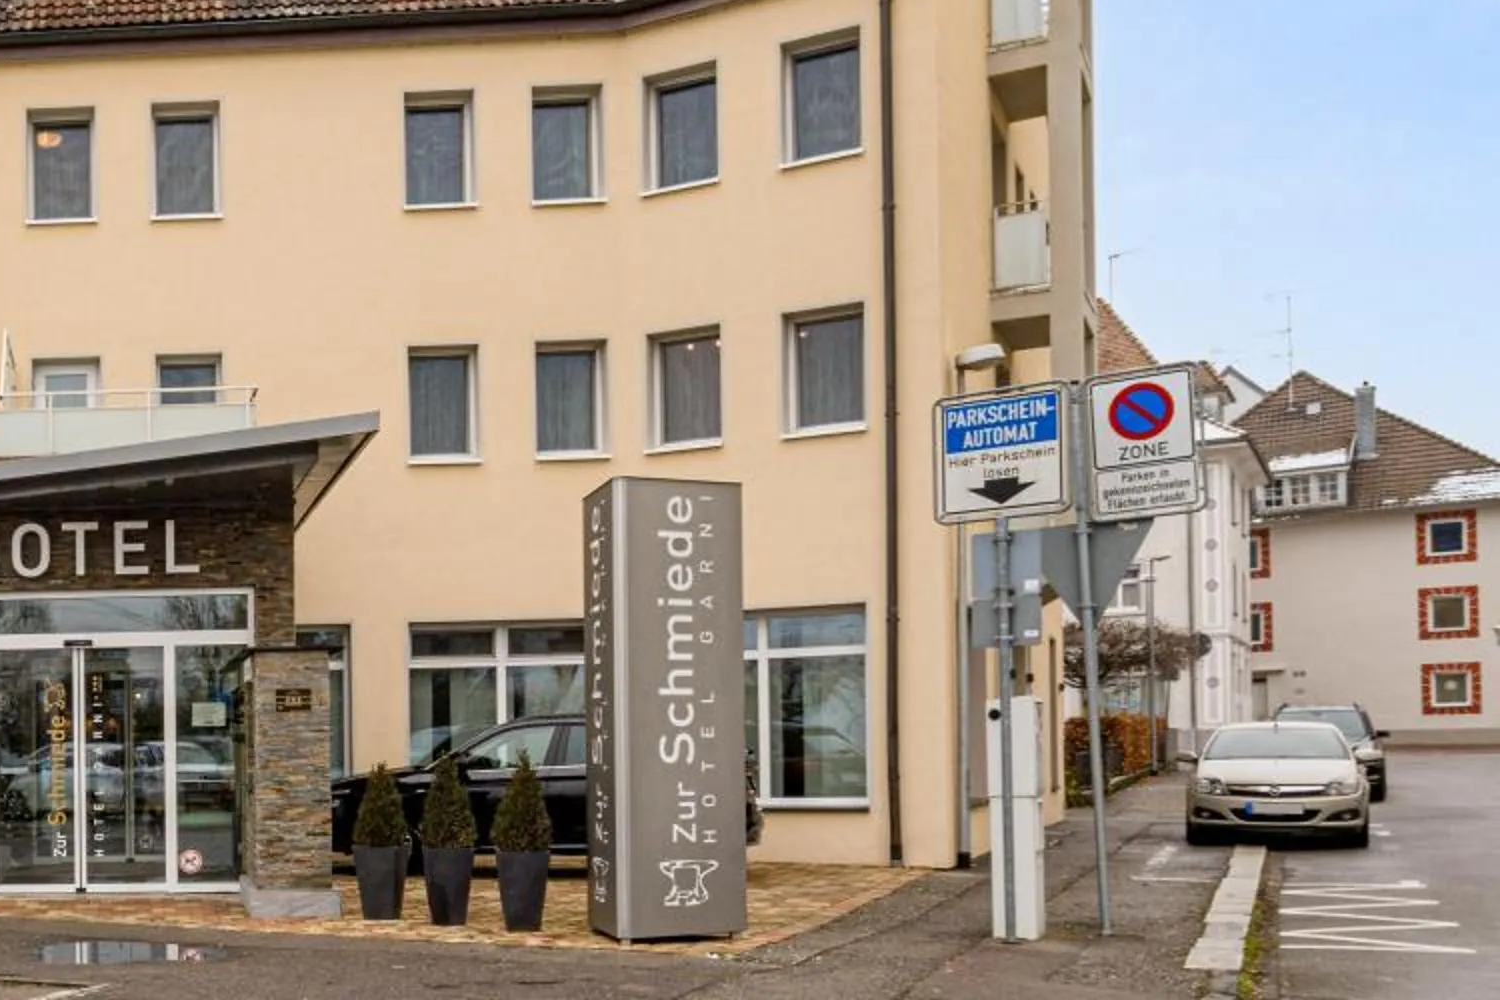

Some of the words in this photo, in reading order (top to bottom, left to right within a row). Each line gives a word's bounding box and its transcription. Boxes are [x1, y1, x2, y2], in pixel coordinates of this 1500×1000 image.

[946, 397, 1055, 429] PARKSCHEIN-
[963, 421, 1039, 449] AUTOMAT
[980, 446, 1056, 464] Parkschein
[1118, 441, 1170, 460] ZONE
[699, 495, 716, 643] GARNI
[657, 495, 696, 765] Schmiede
[46, 714, 67, 825] Schmiede
[700, 690, 718, 843] HOTEL
[93, 791, 105, 857] HOTEL
[672, 781, 697, 843] Zur
[53, 831, 67, 857] Zur
